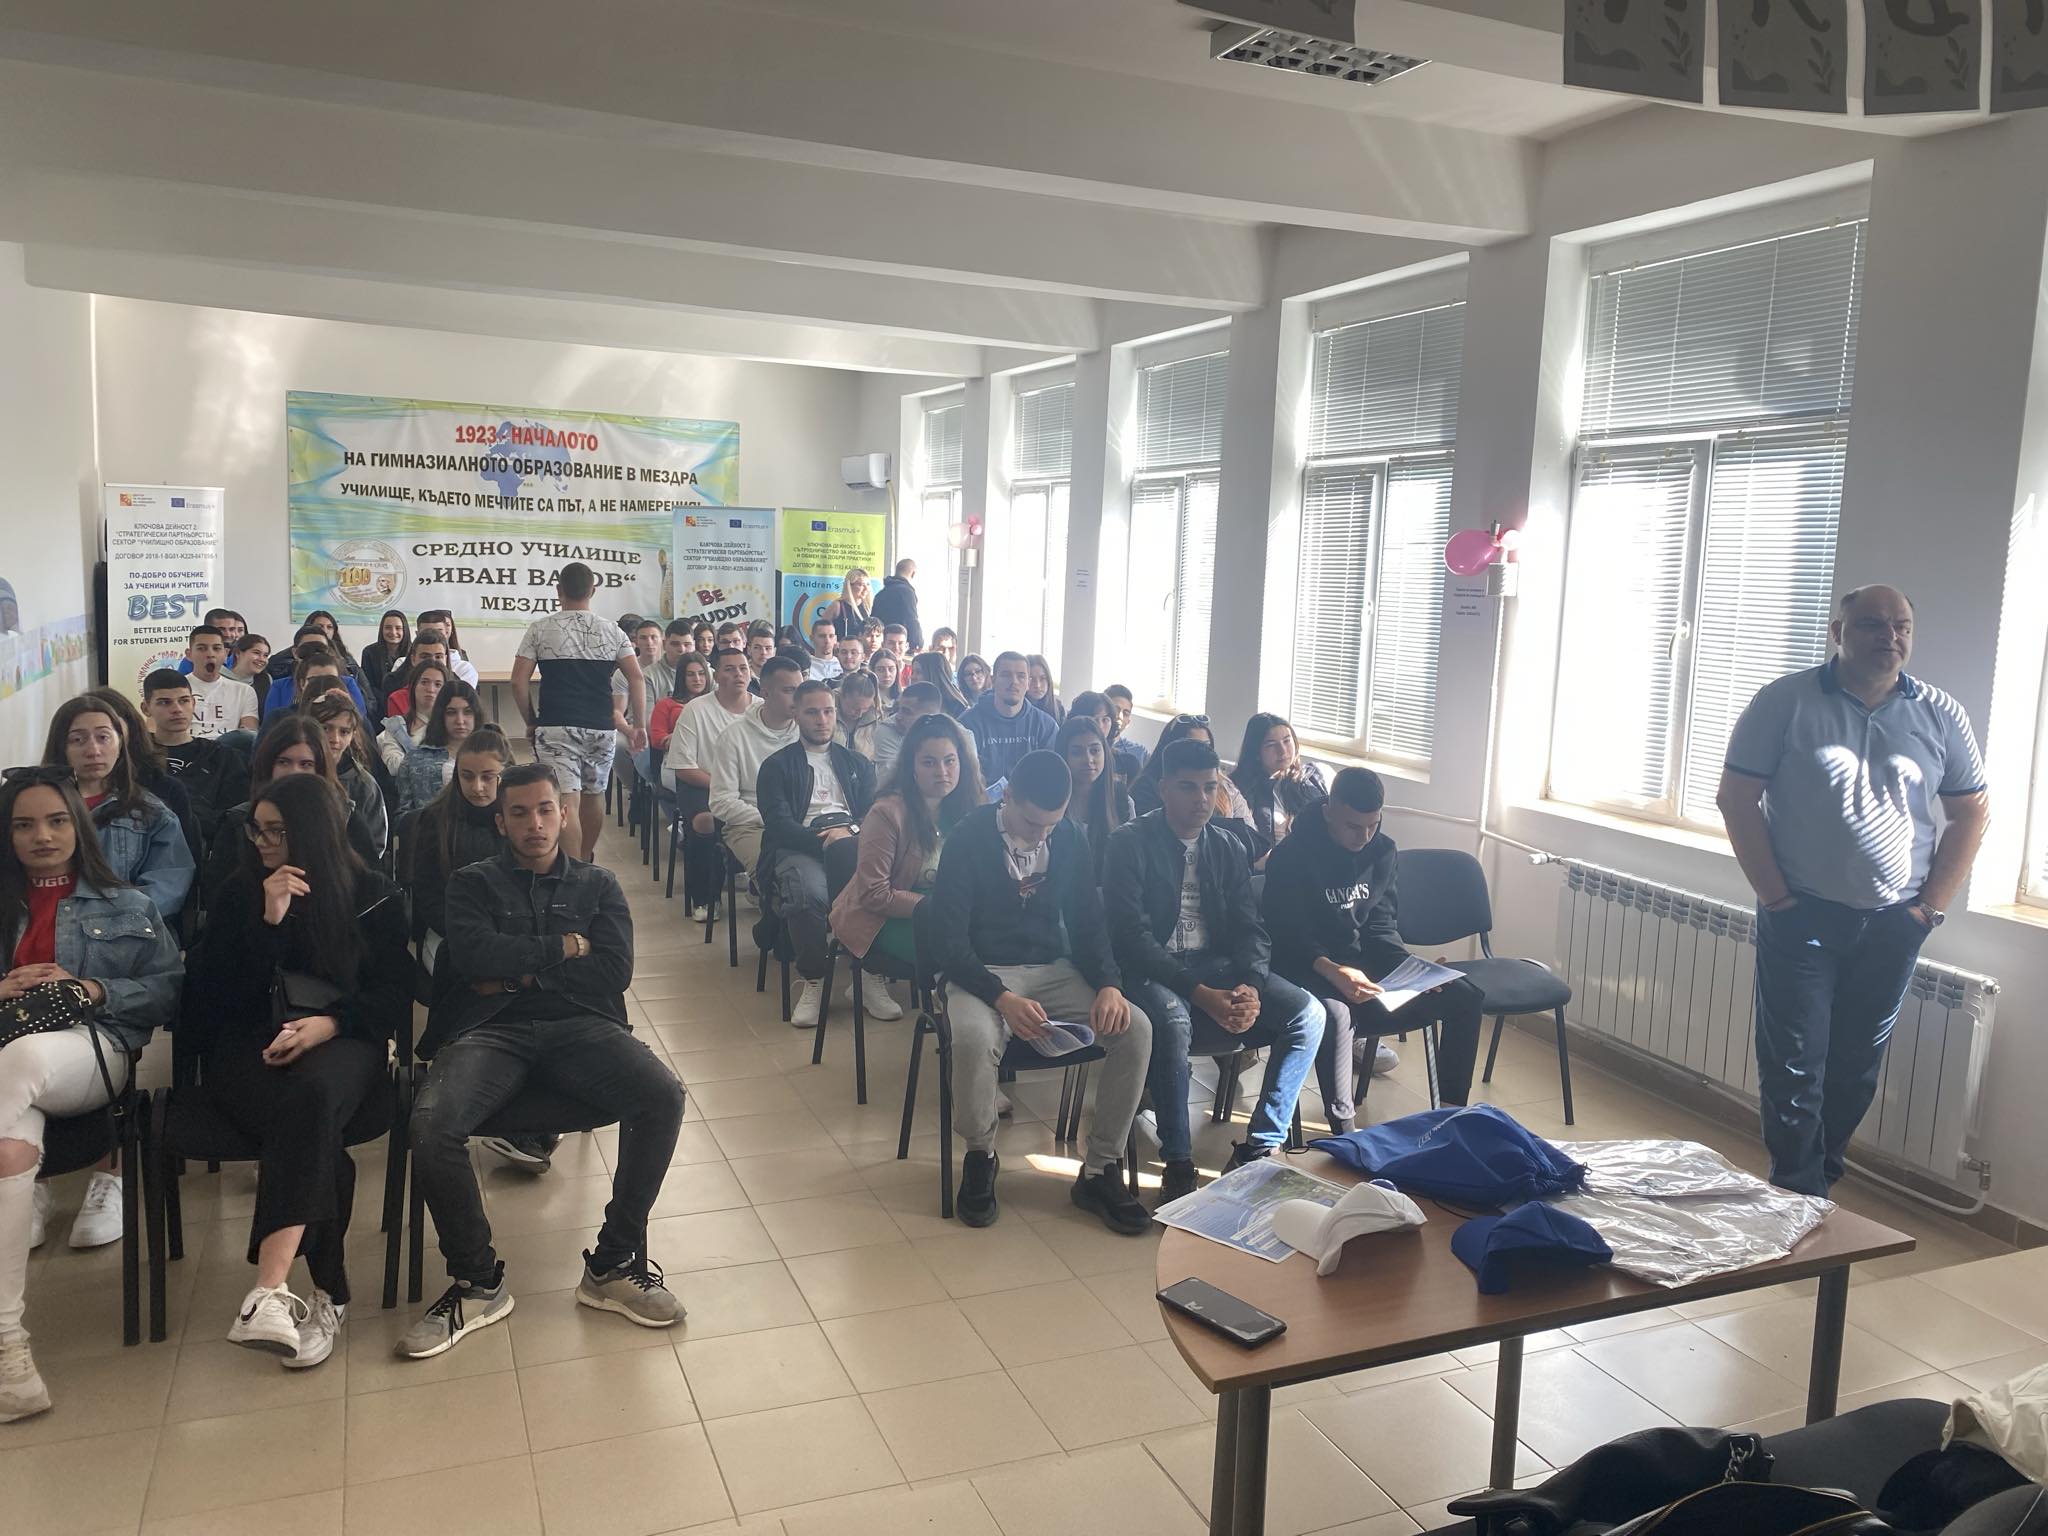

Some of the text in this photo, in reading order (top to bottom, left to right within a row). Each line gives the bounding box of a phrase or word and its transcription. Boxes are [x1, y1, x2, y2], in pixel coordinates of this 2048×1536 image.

[511, 426, 599, 451] НАЧАЛОТО
[344, 452, 698, 486] НА ГИМНАЗИАЛНОТО ОБРАЗОВАНИЕ В МЕЗДРА
[341, 483, 415, 503] УЧИЛИЩЕ,
[418, 489, 471, 507] КЪДЕТО
[475, 494, 534, 511] МЕЧТИТЕ
[538, 498, 552, 512] СА
[558, 499, 585, 516] ПЪТ,
[588, 499, 596, 512] А
[600, 499, 616, 512] НЕ
[412, 541, 642, 565] СРЕДНО УЧИЛИЩЕ
[129, 572, 167, 580] ПО-ДОБРО
[418, 567, 636, 588] „ИВАН ВАОВ“
[793, 580, 840, 590] Children's
[136, 582, 170, 590] УЧЕНИЦИ
[481, 596, 562, 614] МЕЗДР
[696, 588, 726, 606] BE
[128, 594, 208, 621] BEST
[164, 625, 196, 633] EDUCATIO
[130, 636, 168, 644] STUDENTS
